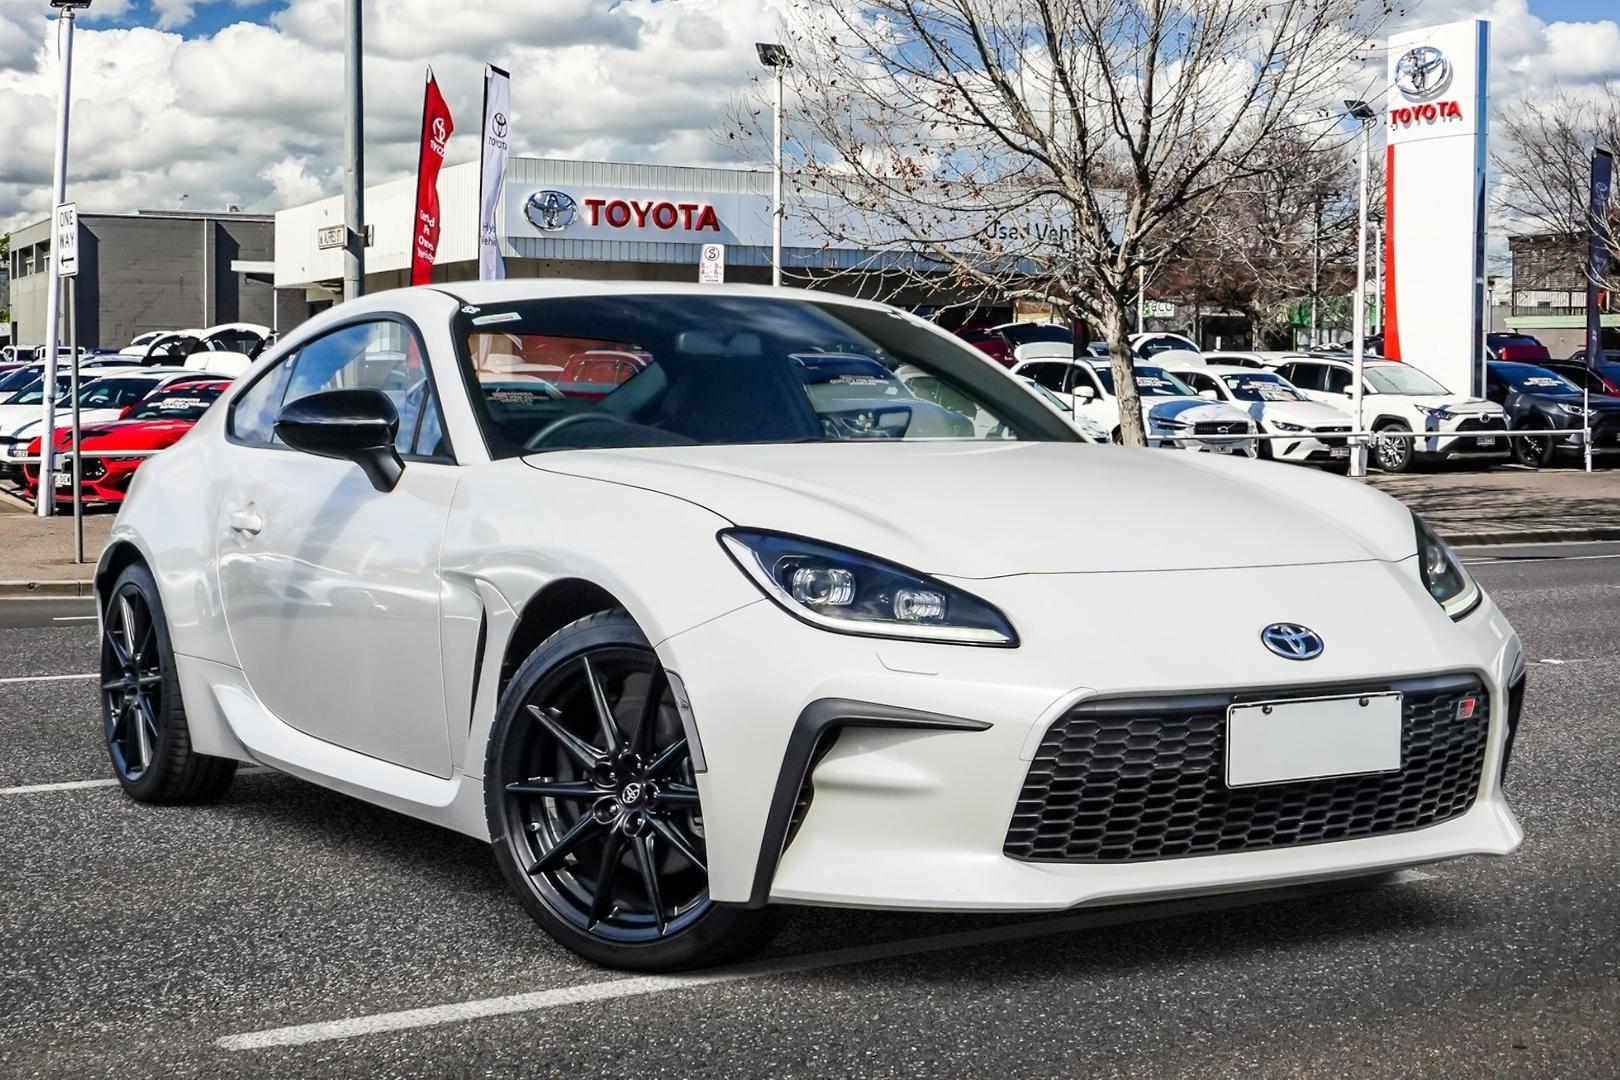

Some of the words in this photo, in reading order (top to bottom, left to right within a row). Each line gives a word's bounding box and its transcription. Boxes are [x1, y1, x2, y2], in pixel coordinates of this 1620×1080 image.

[1389, 100, 1462, 125] TOYOTA
[60, 209, 74, 227] ONE
[584, 199, 720, 232] TOYOTA
[59, 231, 74, 249] WAY
